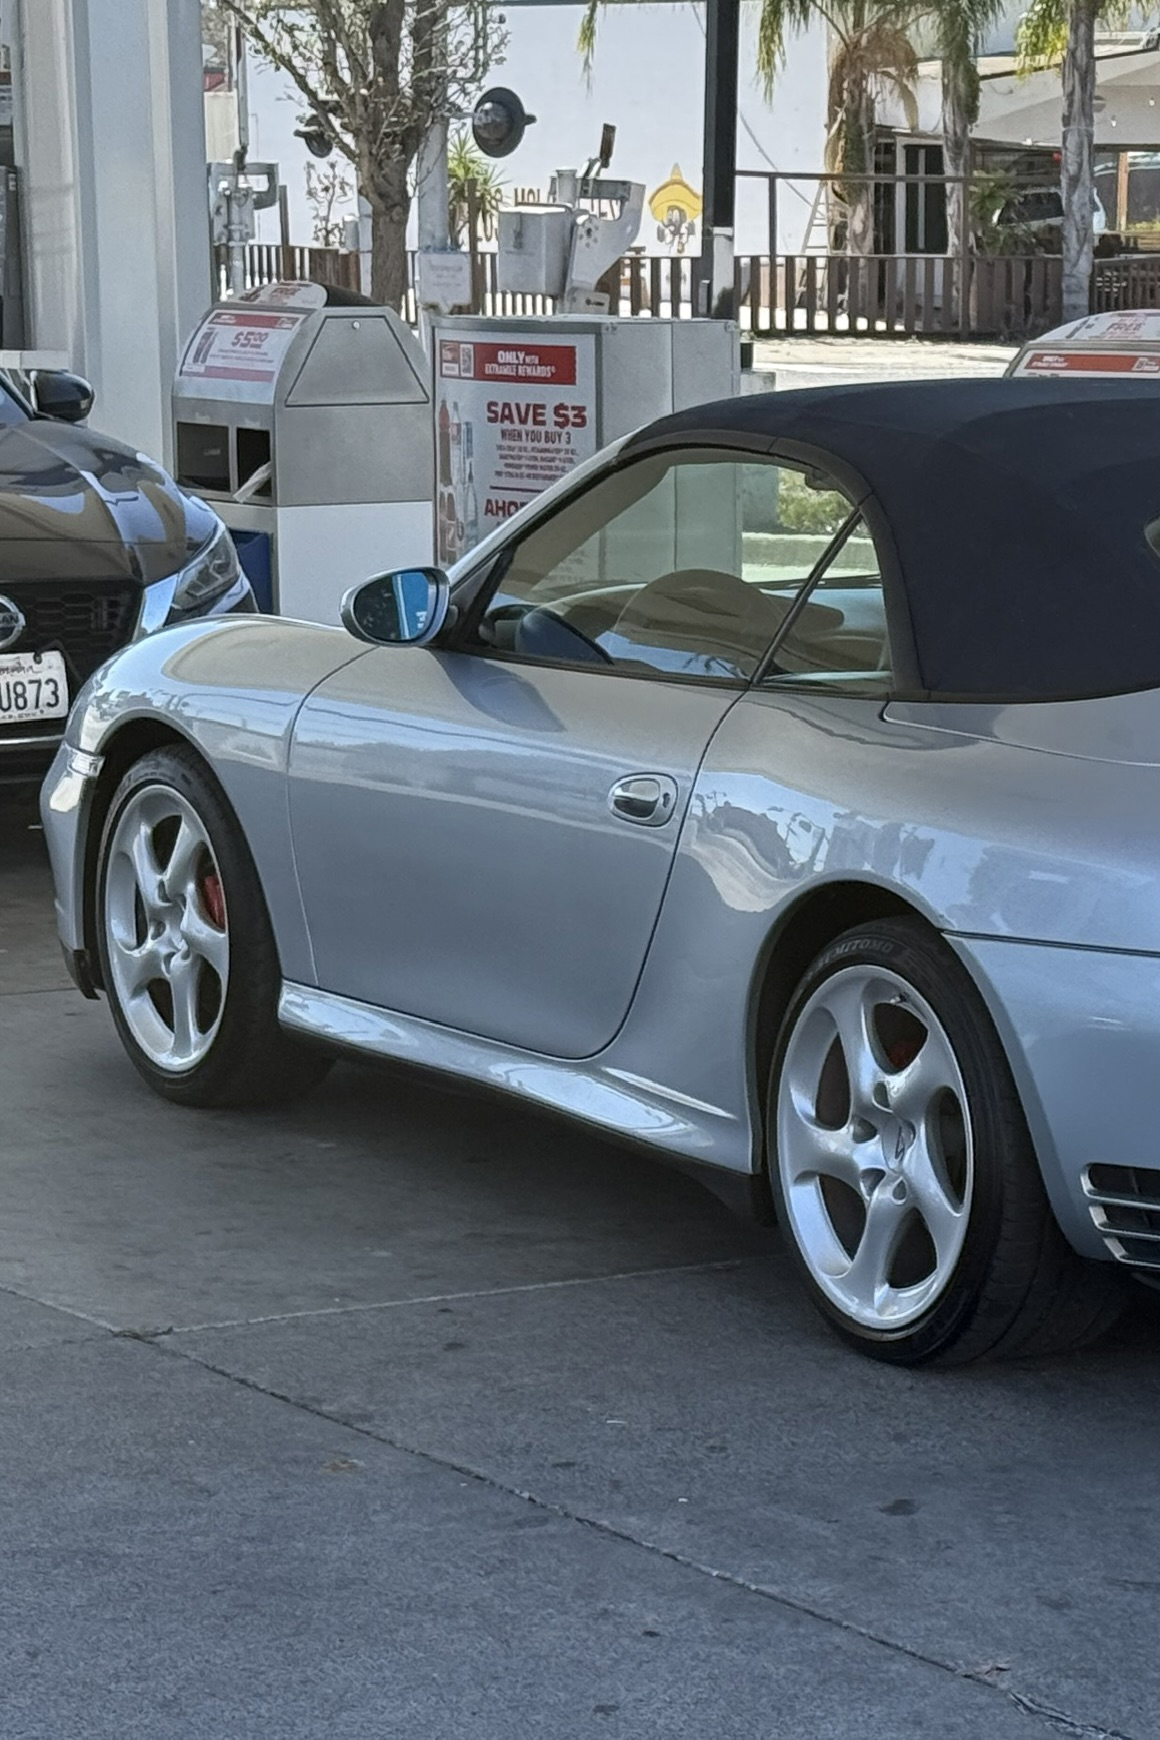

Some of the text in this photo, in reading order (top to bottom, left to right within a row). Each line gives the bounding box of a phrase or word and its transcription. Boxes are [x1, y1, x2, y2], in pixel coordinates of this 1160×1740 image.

[497, 350, 525, 364] ONLY
[486, 401, 587, 430] SAVE $3
[501, 429, 572, 445] WHEN YOU BUY 3
[0, 677, 60, 713] U873
